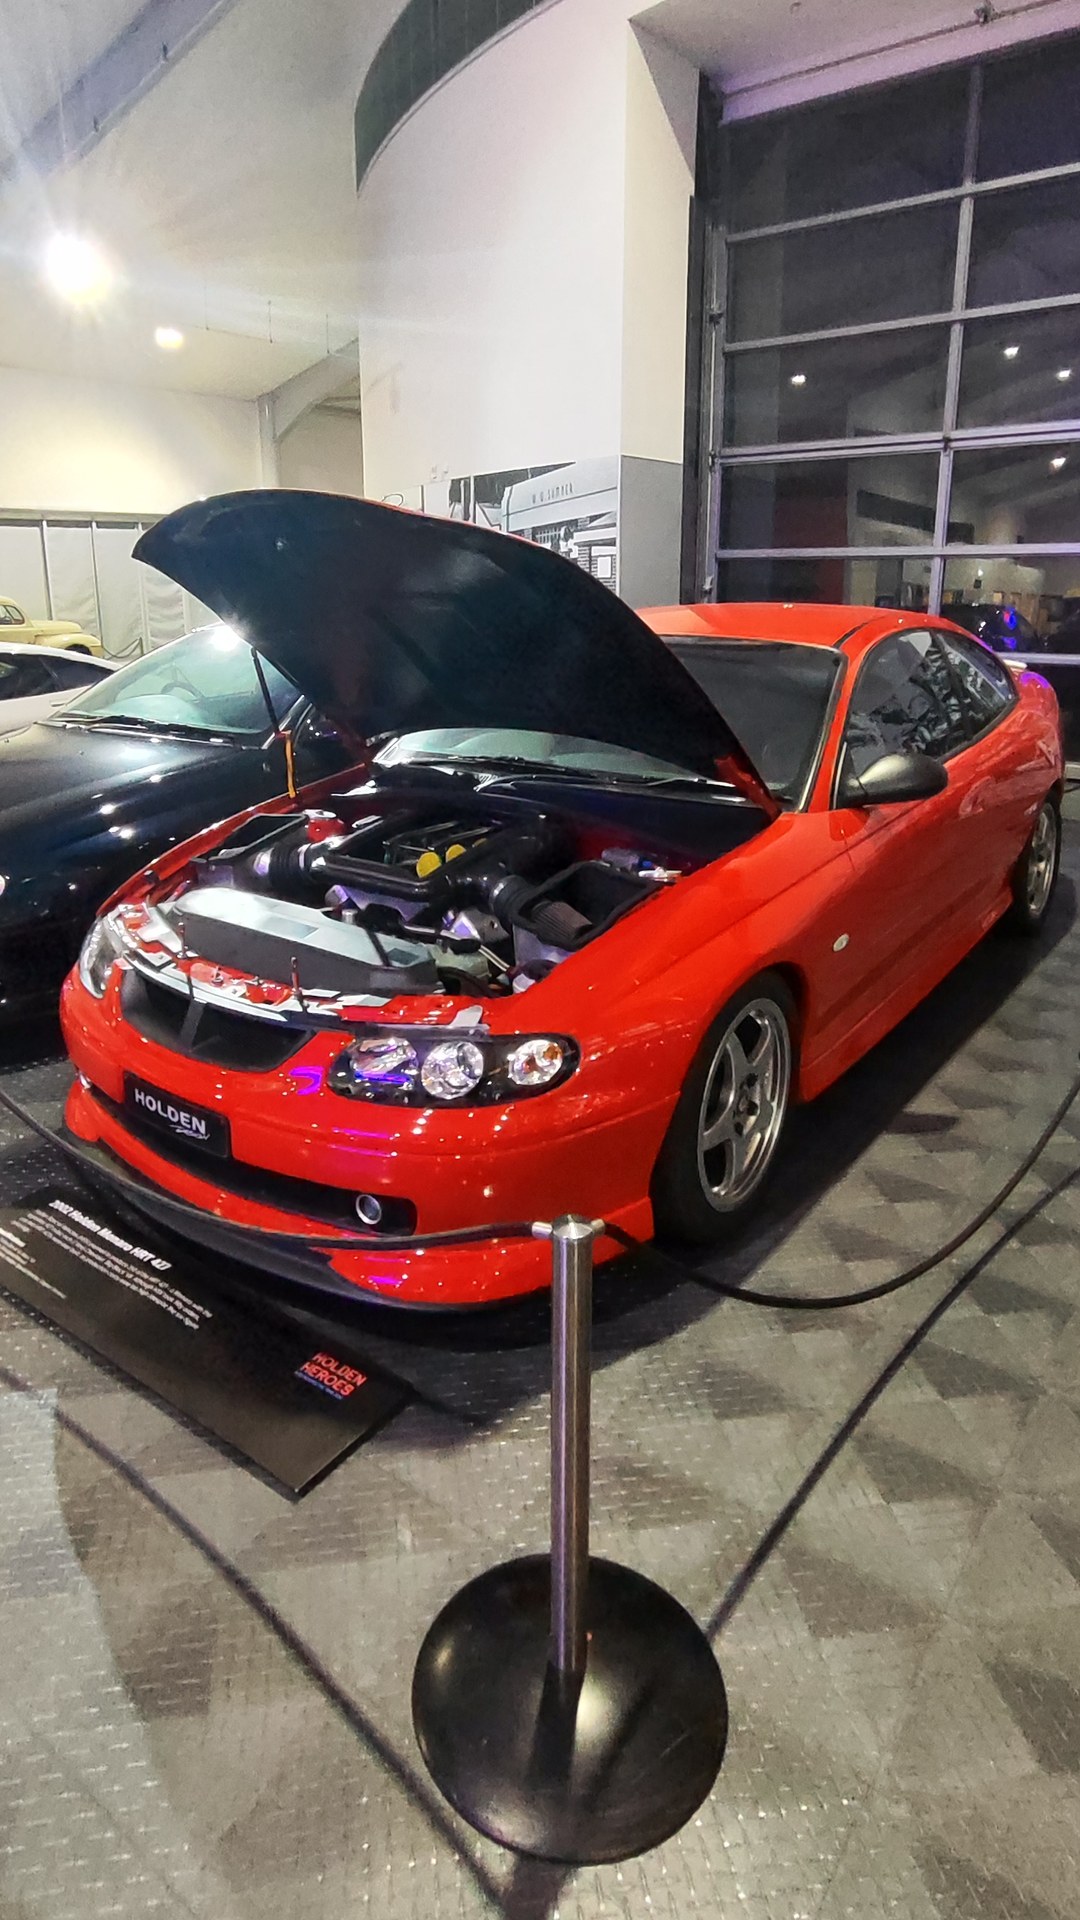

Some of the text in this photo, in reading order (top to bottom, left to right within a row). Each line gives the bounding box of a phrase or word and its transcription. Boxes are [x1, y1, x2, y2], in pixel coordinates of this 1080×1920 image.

[134, 1088, 206, 1135] HOLDEN
[68, 1210, 101, 1232] Holden
[97, 1227, 134, 1251] Monaro
[129, 1247, 156, 1262] HRT
[300, 1361, 355, 1396] HEROES
[312, 1351, 368, 1387] HOLDEN
